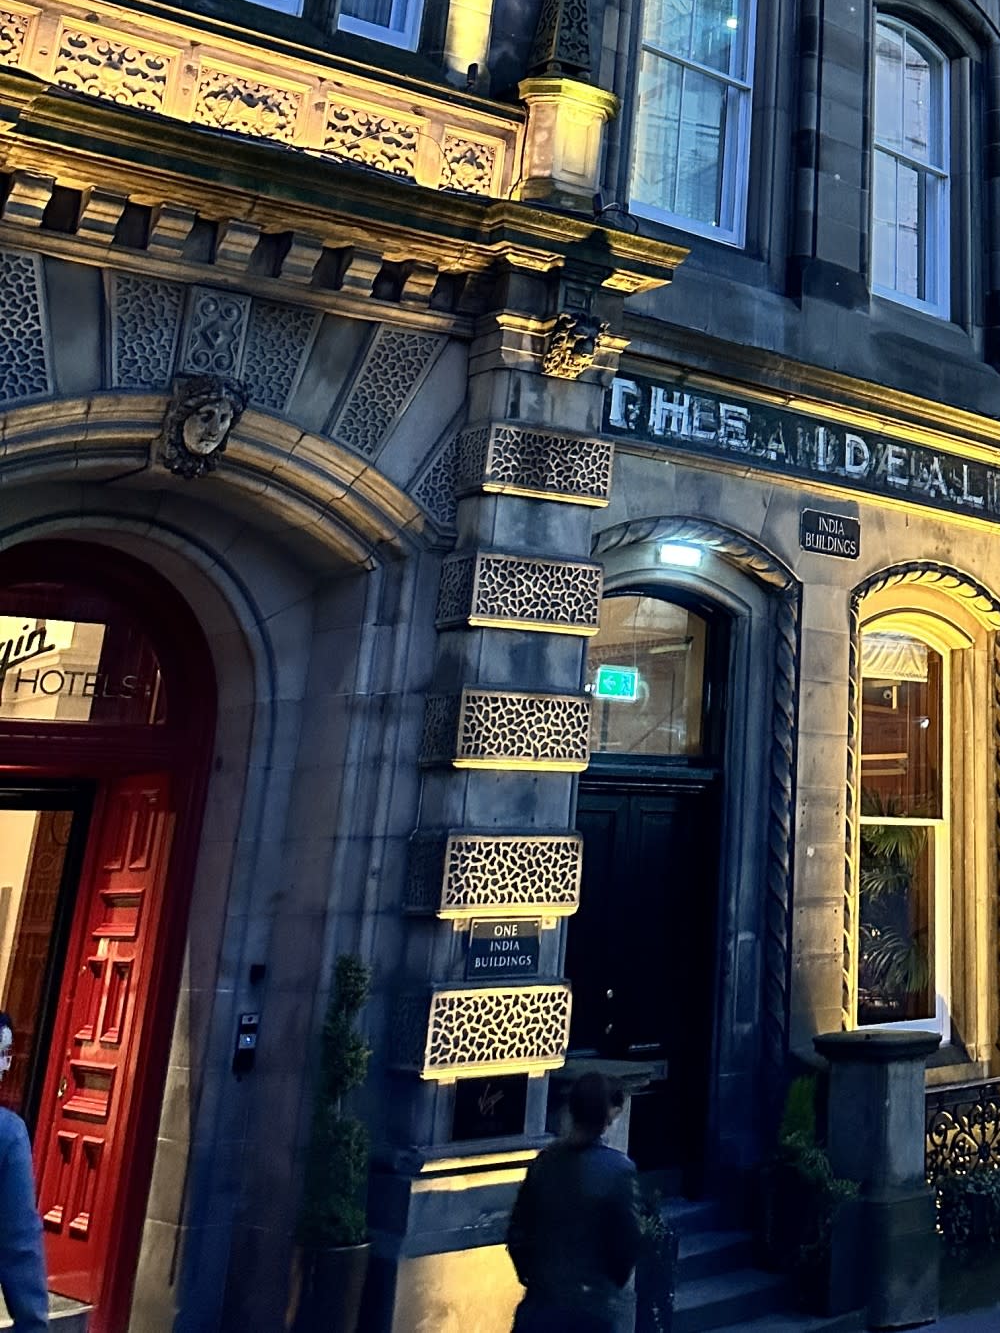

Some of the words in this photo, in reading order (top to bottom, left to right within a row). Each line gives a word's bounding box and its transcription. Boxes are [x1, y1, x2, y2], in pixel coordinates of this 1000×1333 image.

[814, 426, 985, 508] IDEAL
[818, 516, 845, 536] INDIA
[805, 532, 857, 556] BUILDINGS
[14, 668, 138, 700] HOTELS
[494, 924, 518, 937] ONE
[490, 940, 520, 952] INDIA
[475, 955, 532, 968] BUILDINGS
